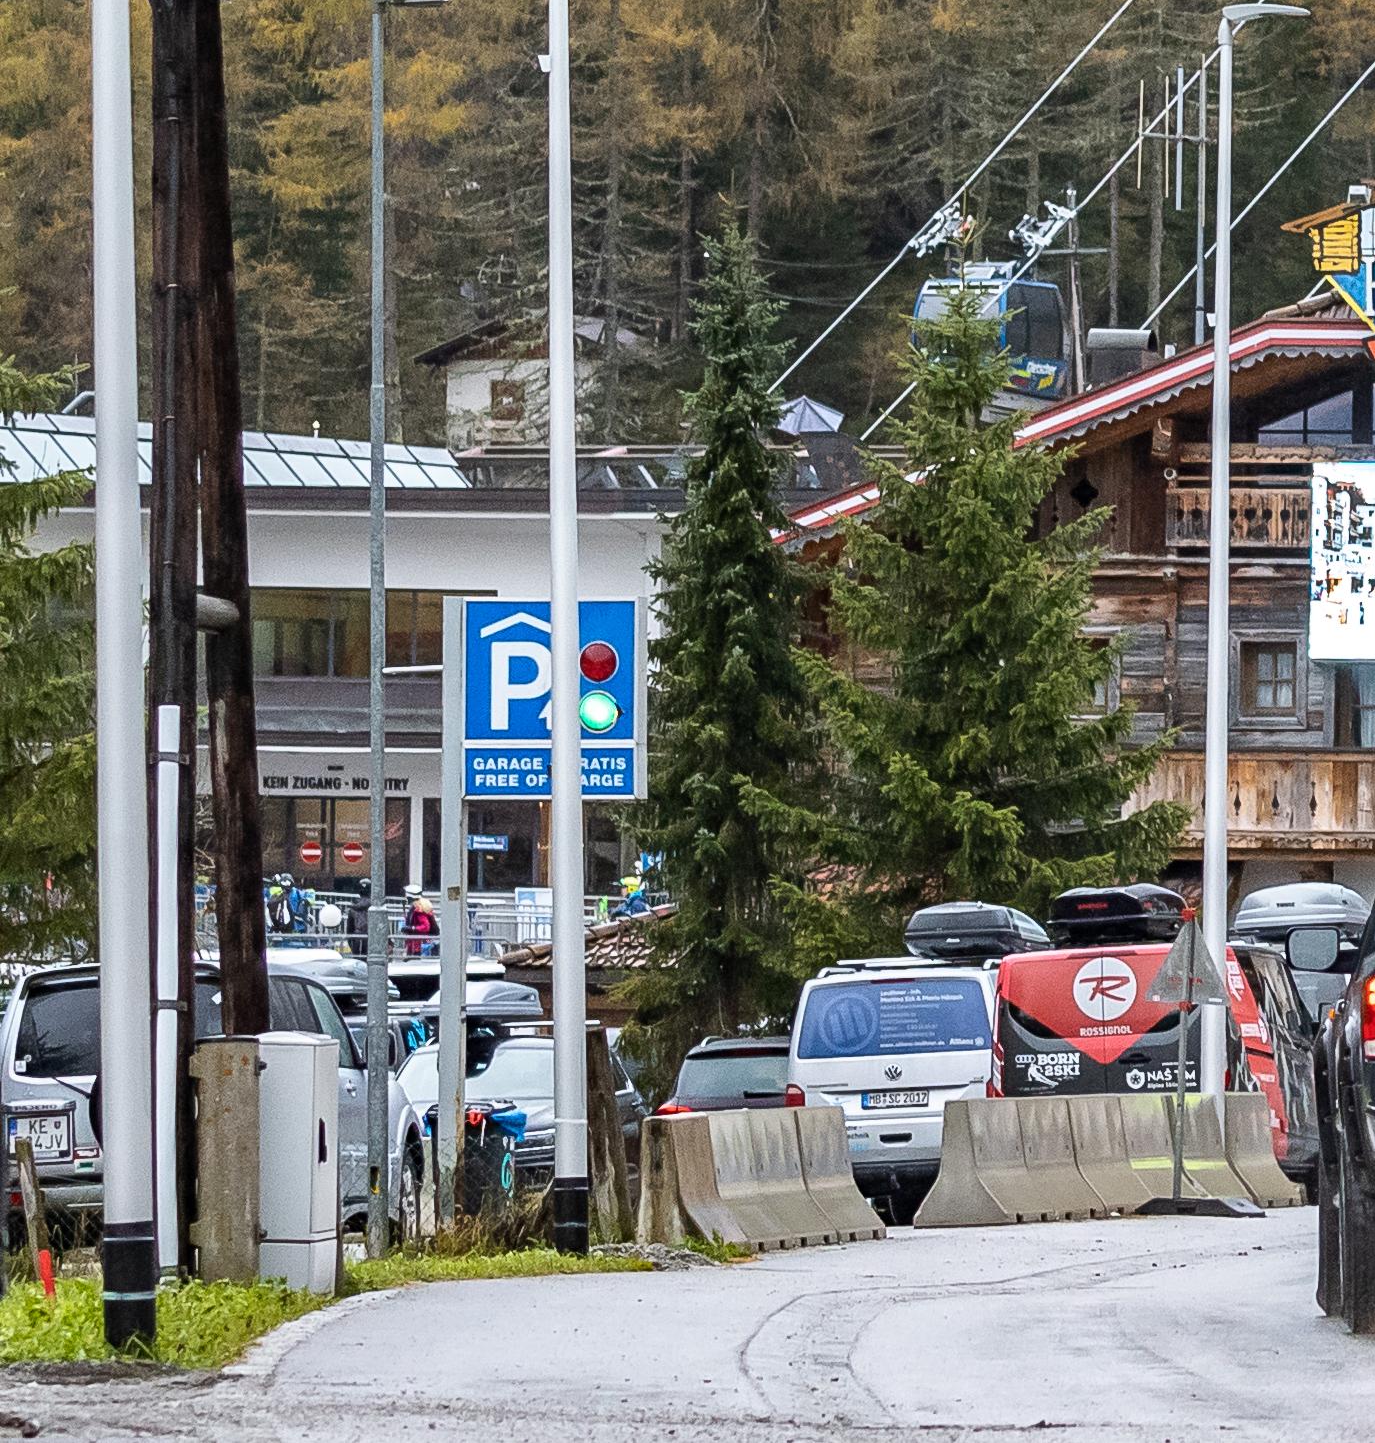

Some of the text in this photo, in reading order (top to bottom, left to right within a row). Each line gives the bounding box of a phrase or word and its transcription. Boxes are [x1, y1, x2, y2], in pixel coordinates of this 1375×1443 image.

[490, 641, 553, 731] P
[473, 757, 627, 770] GARAGE RATIS
[262, 775, 289, 790] KEIN
[292, 775, 342, 791] ZUGANG
[352, 776, 370, 791] NO
[475, 774, 625, 787] FREE OF ARGE
[1079, 1024, 1133, 1037] ROSSIGNOL
[1036, 1052, 1081, 1066] BORN
[1044, 1064, 1081, 1077] 2SKI
[867, 1091, 928, 1105] MB SC 2017
[28, 1118, 49, 1135] KE
